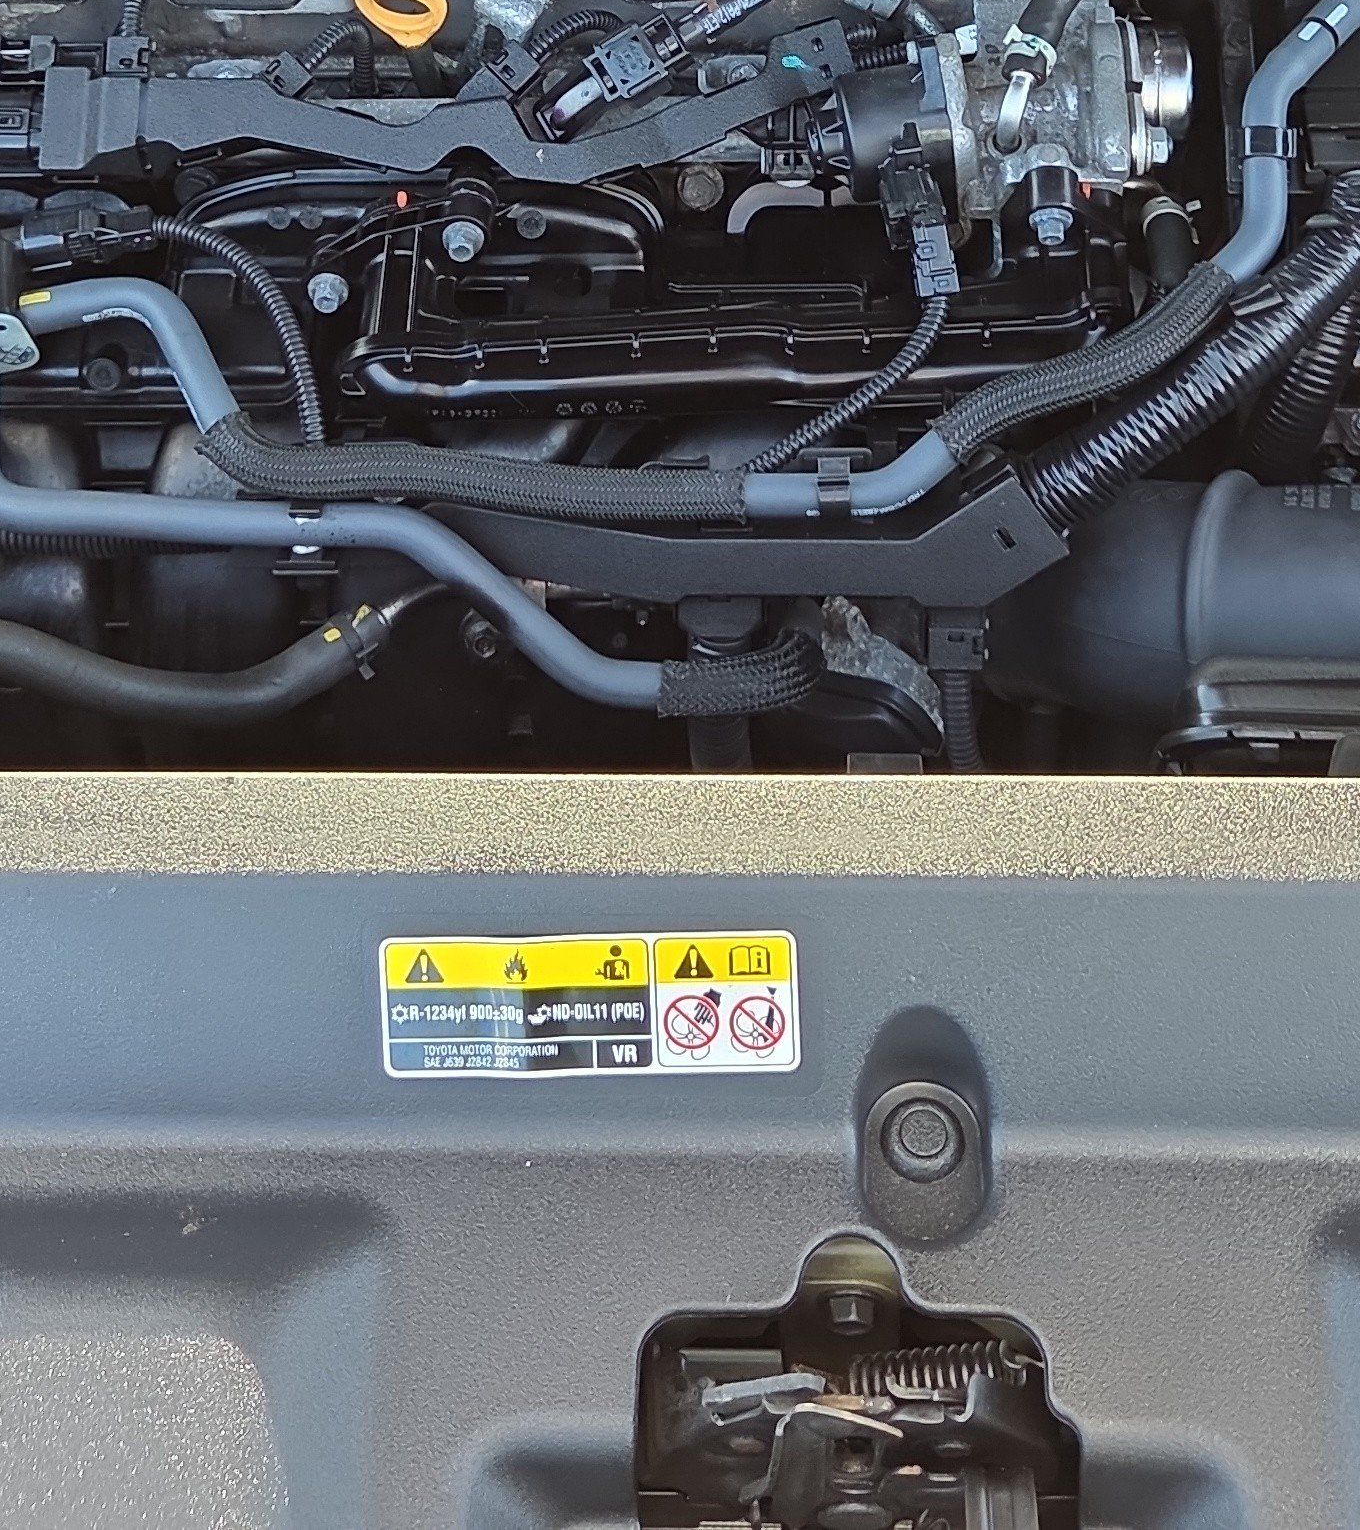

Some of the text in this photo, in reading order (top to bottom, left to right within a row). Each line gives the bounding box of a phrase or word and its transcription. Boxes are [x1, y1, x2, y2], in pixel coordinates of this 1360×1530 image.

[611, 1001, 645, 1021] (POE)
[423, 1043, 559, 1057] TOYOTA MOTOR CORPORATION
[611, 1044, 638, 1064] VR
[423, 1056, 520, 1069] SAE J639 J2842 J2845
